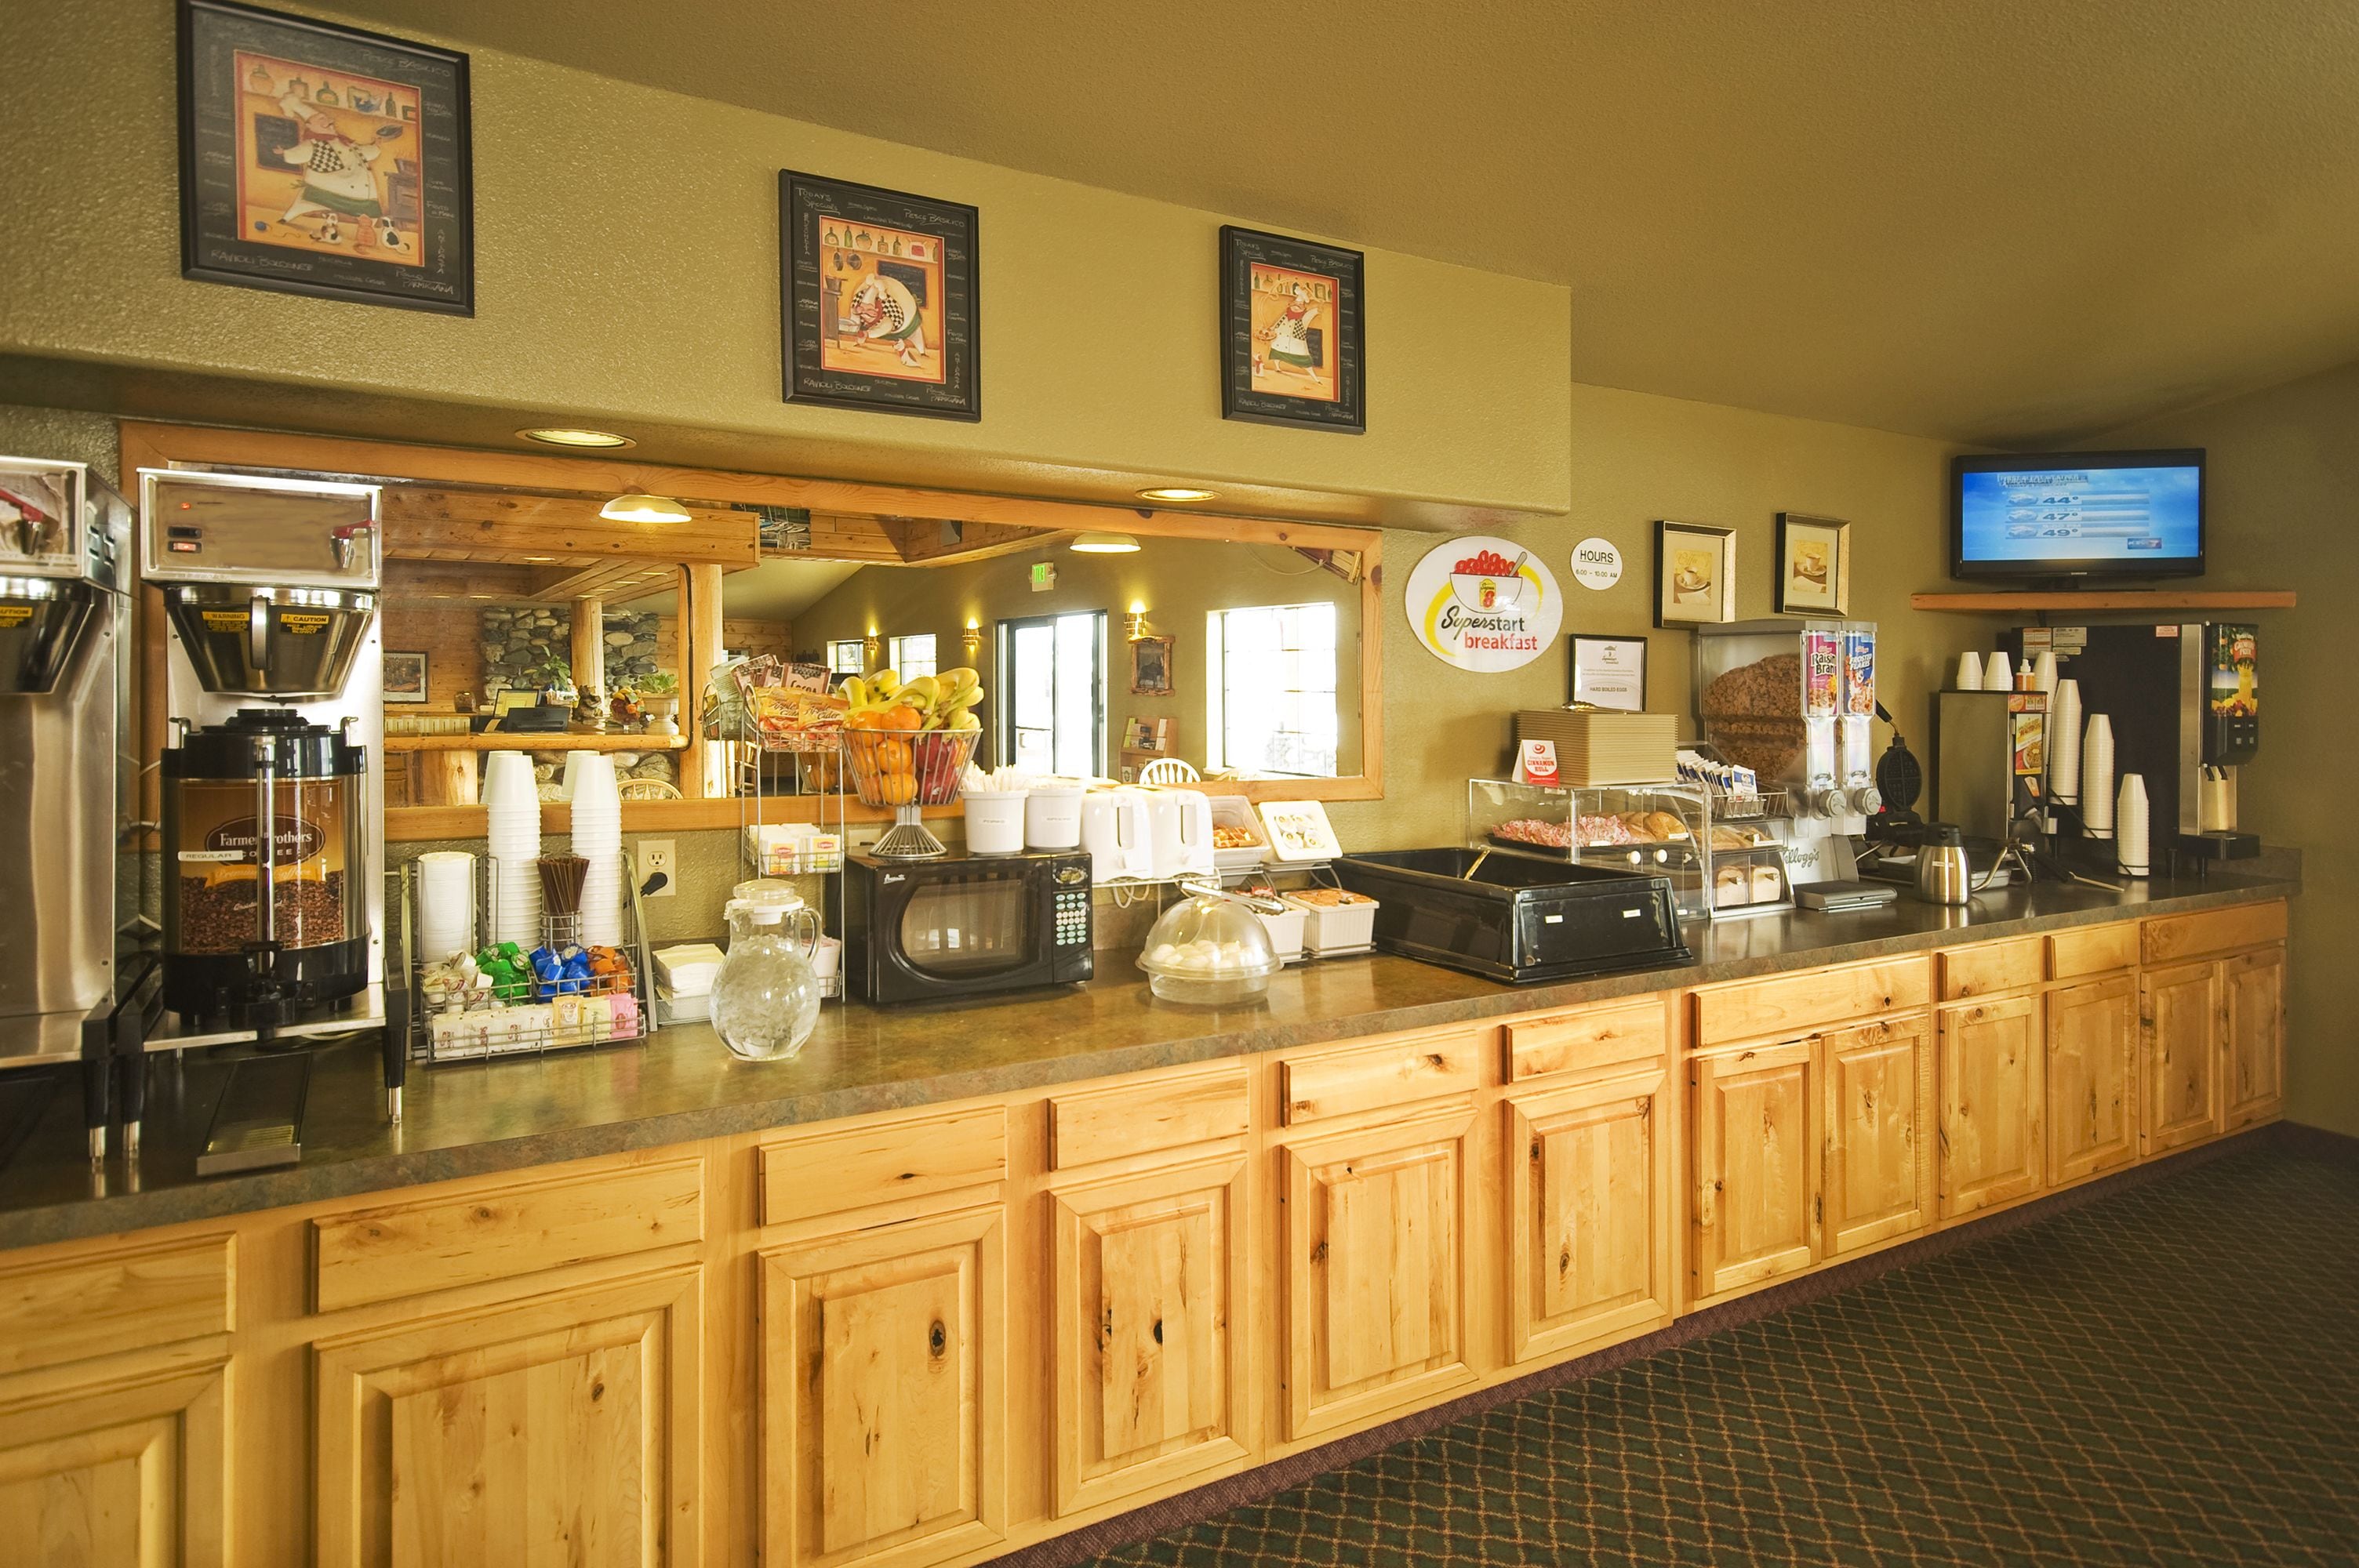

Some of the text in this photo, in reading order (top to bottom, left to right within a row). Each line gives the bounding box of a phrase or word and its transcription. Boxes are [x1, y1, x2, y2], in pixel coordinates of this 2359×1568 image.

[1579, 550, 1614, 563] HOURS
[1441, 605, 1525, 641] Superstart
[1464, 632, 1537, 651] breakfast
[1816, 663, 1835, 674] Bran
